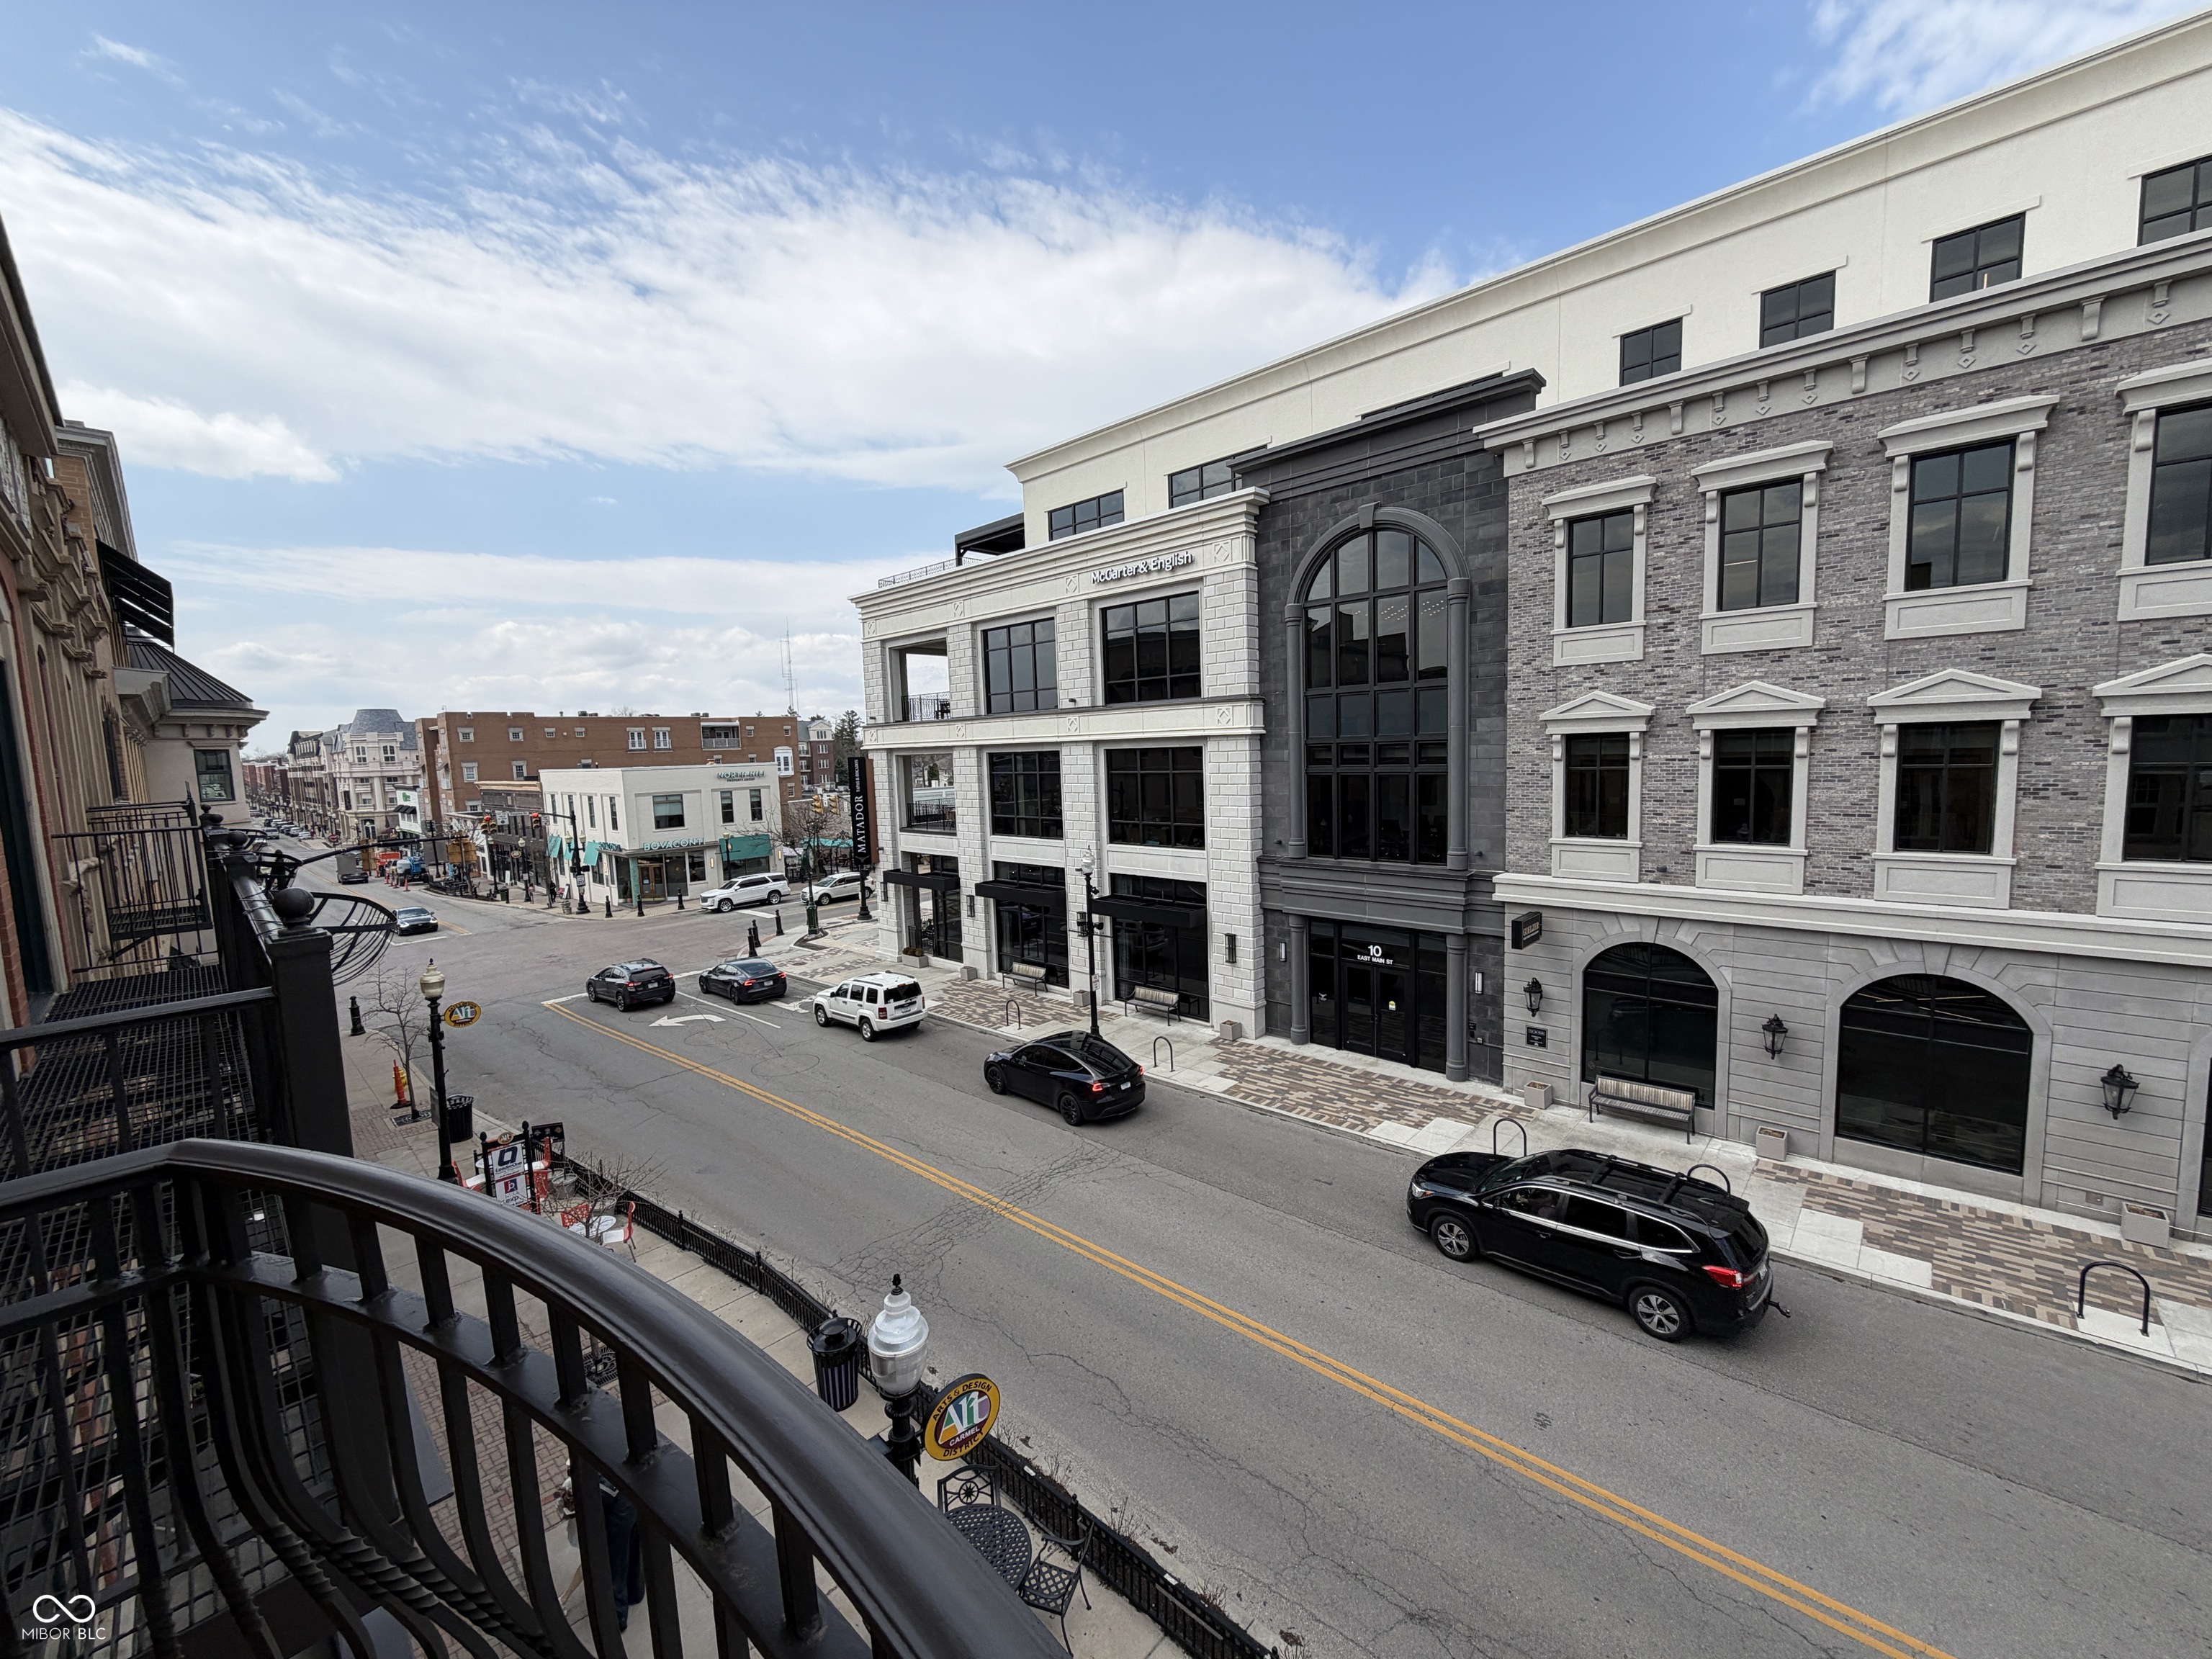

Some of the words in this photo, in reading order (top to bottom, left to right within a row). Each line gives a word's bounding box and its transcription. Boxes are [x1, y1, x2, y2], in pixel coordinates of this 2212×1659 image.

[1090, 567, 1138, 584] McCarter
[1138, 560, 1148, 574] &
[1151, 552, 1194, 571] English
[854, 795, 866, 853] MATADOR
[643, 837, 706, 851] BOVACONTI
[1368, 945, 1382, 957] 10
[451, 1005, 477, 1021] Art
[495, 1161, 523, 1172] LeaderOne
[932, 1394, 953, 1421] ARTS
[962, 1381, 992, 1393] DESIGN
[938, 1391, 989, 1444] Art
[943, 1429, 984, 1457] DISTRICT
[949, 1426, 980, 1447] CARMEL
